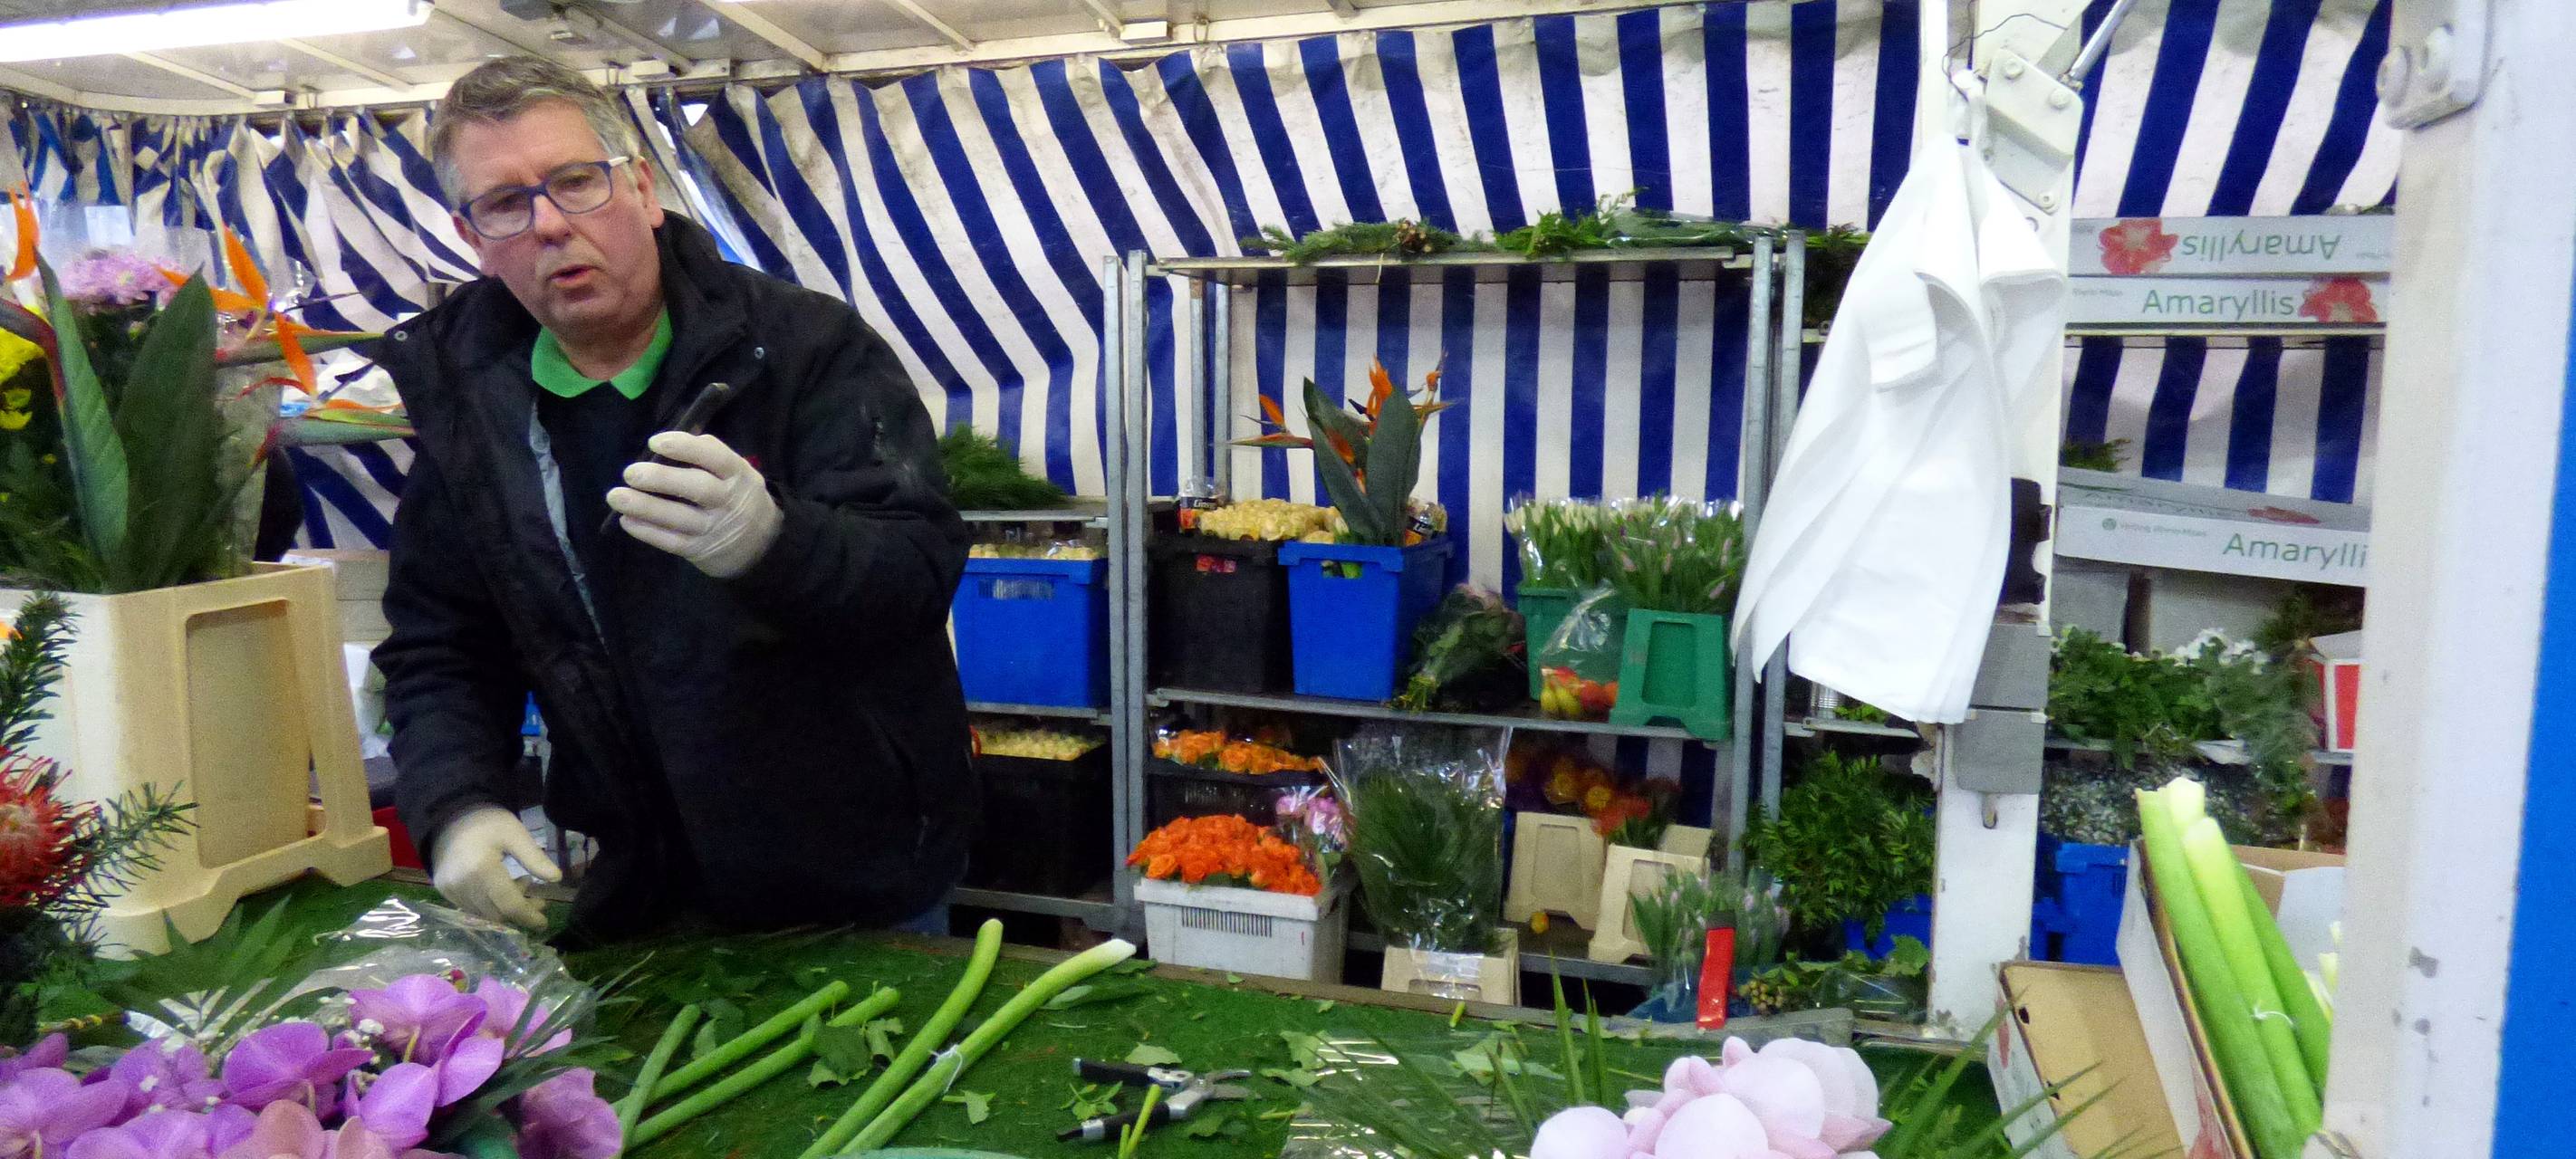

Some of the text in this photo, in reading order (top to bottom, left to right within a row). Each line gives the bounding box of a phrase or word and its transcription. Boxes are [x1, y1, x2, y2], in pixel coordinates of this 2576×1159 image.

[2180, 229, 2341, 261] Amaryllis
[2142, 289, 2294, 321] Amaryllis
[2222, 532, 2369, 570] Amarylli
